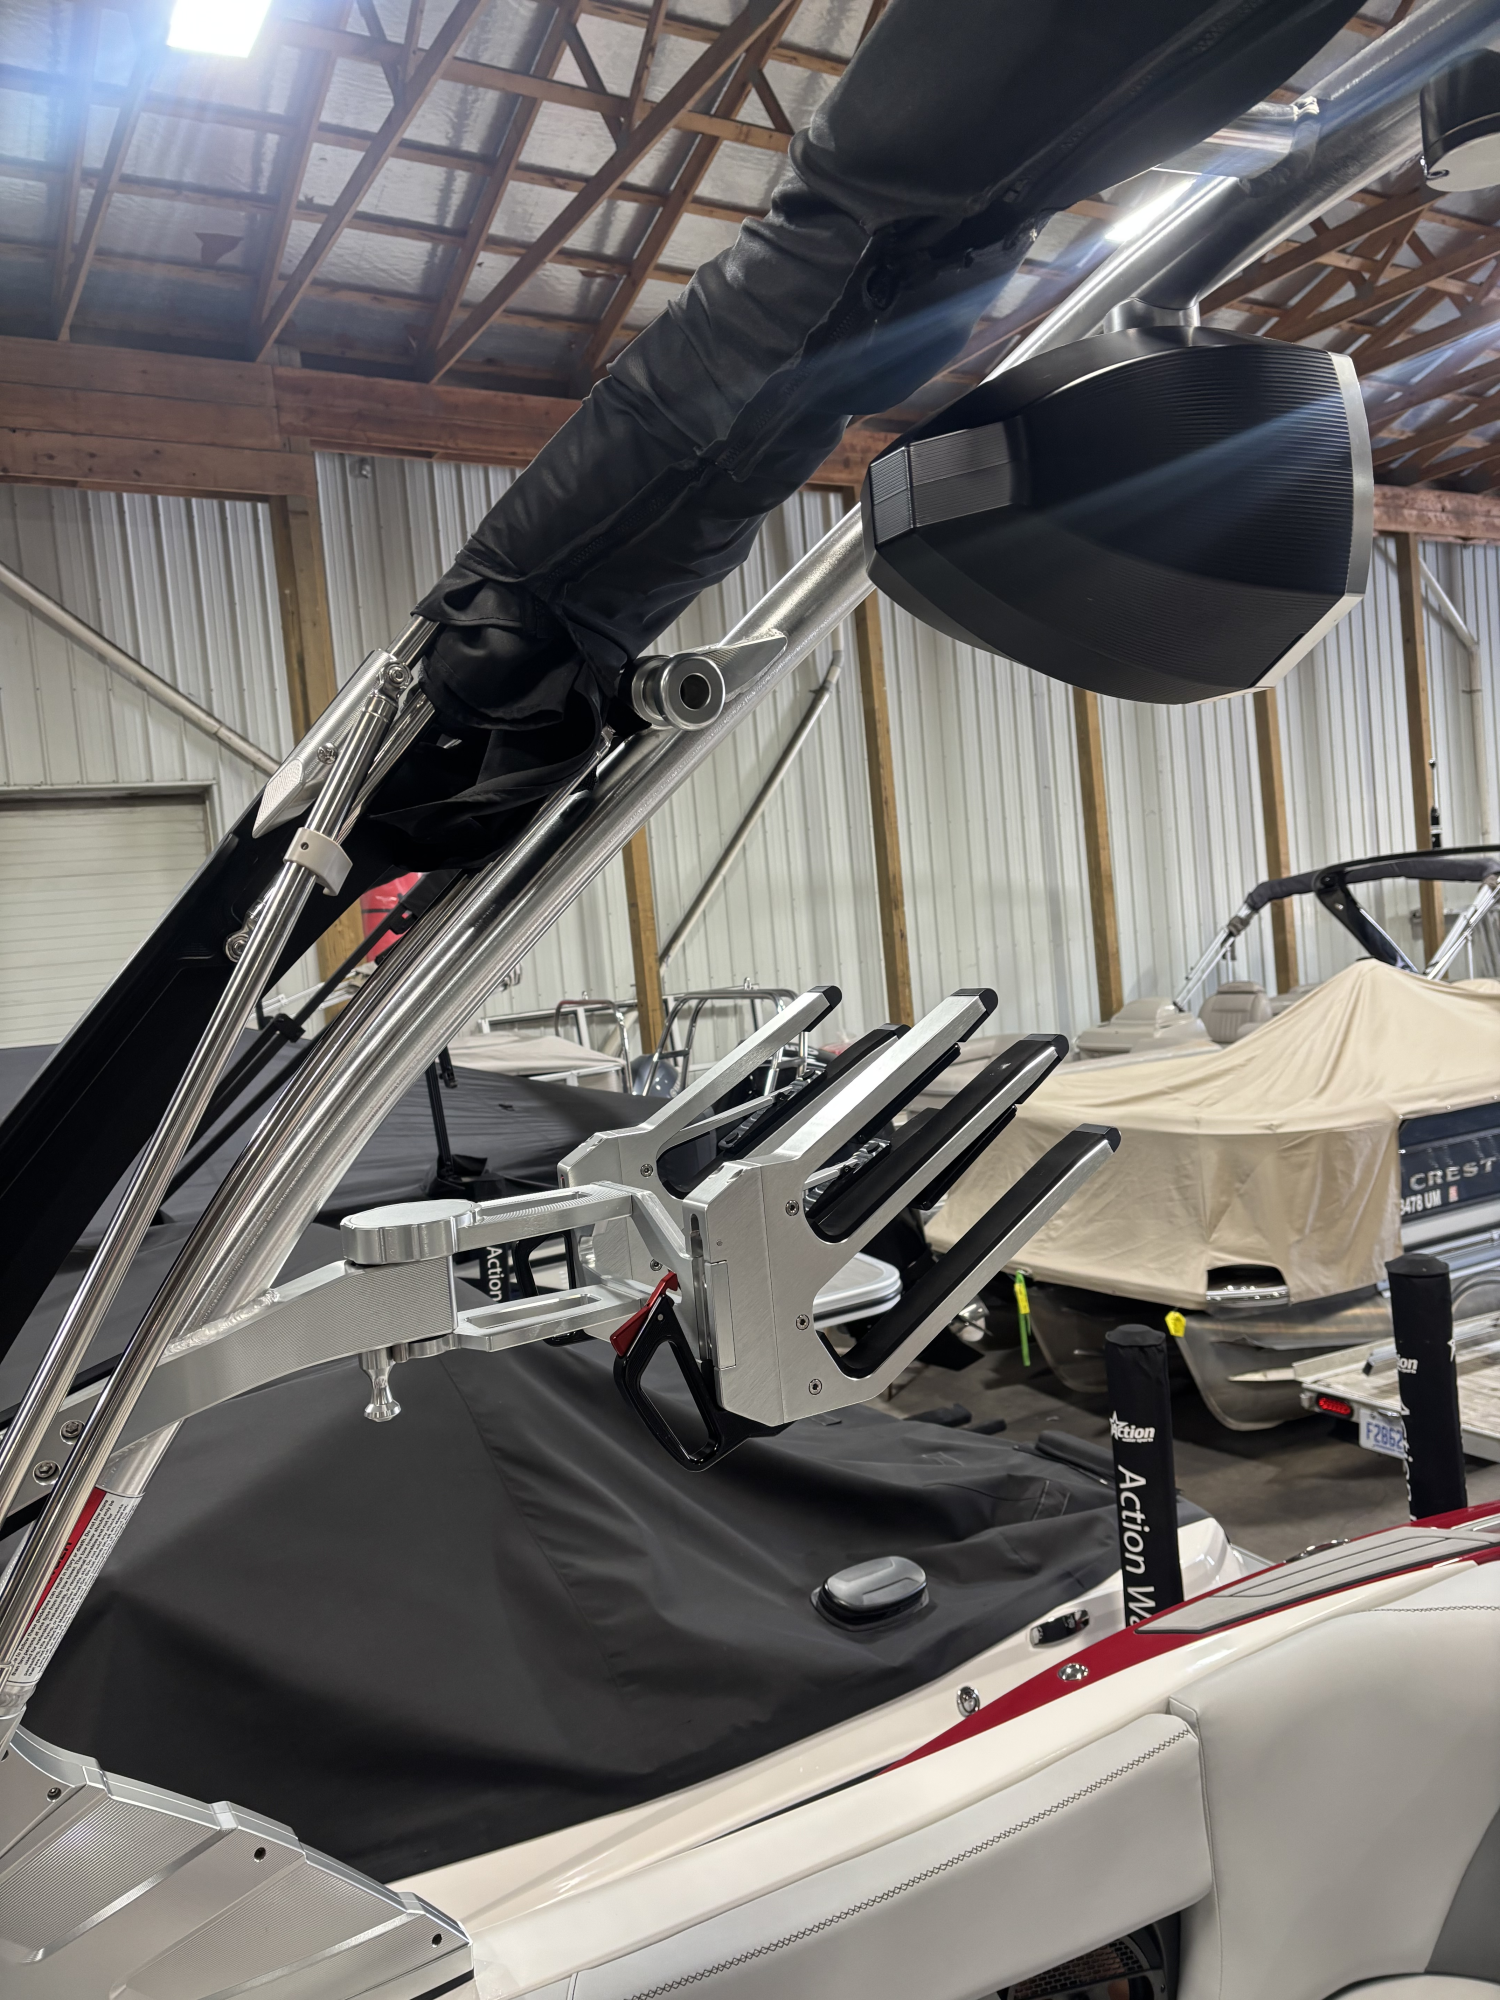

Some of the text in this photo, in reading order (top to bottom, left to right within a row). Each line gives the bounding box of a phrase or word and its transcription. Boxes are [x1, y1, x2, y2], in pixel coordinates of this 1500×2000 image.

[1410, 1156, 1497, 1191] CREST
[1424, 1189, 1442, 1209] UM
[486, 1247, 505, 1302] Action
[1111, 1422, 1155, 1440] Action
[1118, 1464, 1150, 1575] Action
[18, 1637, 29, 1652] follow
[27, 1623, 37, 1637] these
[35, 1600, 51, 1624] guidelines
[54, 1576, 64, 1590] result
[64, 1558, 75, 1571] injury
[84, 1529, 91, 1537] Do
